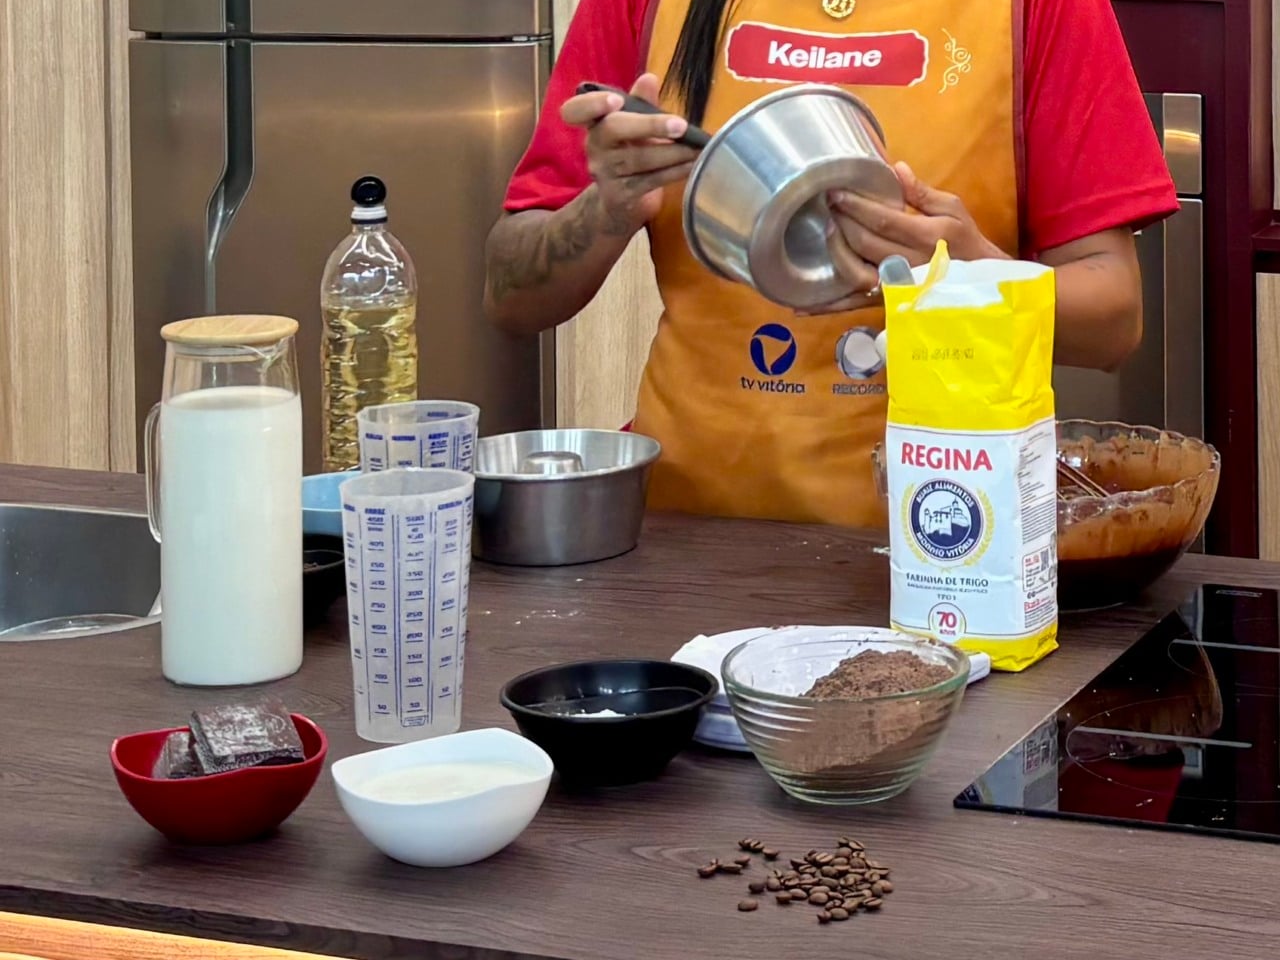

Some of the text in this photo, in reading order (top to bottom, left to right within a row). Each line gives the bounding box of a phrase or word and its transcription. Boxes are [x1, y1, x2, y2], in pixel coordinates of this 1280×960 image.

[768, 40, 882, 69] Keilane
[741, 376, 806, 393] tv vitória
[901, 442, 993, 471] REGINA
[960, 577, 989, 588] TRIGO
[936, 611, 958, 628] 70
